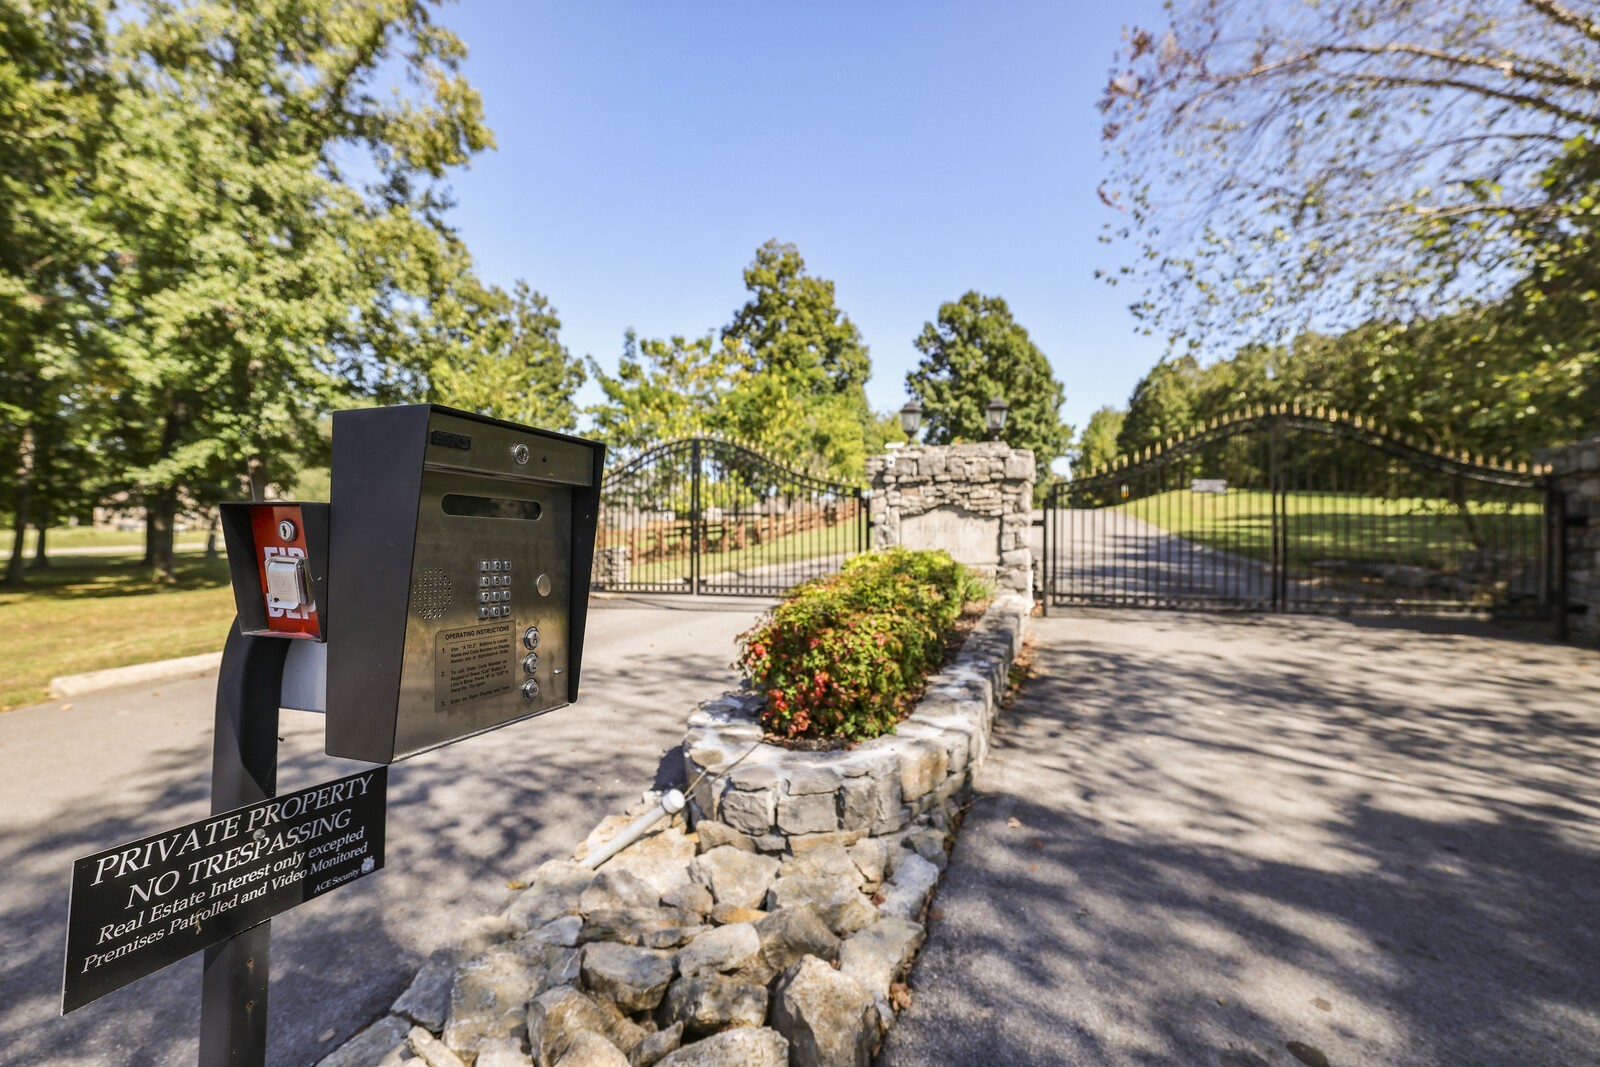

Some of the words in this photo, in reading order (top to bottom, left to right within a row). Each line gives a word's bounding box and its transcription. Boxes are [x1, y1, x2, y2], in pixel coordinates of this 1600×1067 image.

[445, 631, 474, 640] OPERATING
[476, 626, 509, 635] INSTRUCTIONS
[90, 814, 243, 886] PRIVATE
[244, 773, 374, 832] PROPERTY
[124, 870, 180, 910] NO
[188, 808, 351, 885] TRESPASSING
[314, 879, 332, 894] ACE
[332, 867, 360, 886] Security
[81, 929, 164, 974] Premises
[167, 897, 238, 936] Patrolled
[240, 882, 267, 904] and
[271, 868, 308, 891] Video
[309, 842, 368, 876] Monitored
[96, 911, 143, 945] Real
[148, 891, 206, 924] Estate
[209, 866, 270, 899] Interest
[274, 850, 305, 877] only
[308, 826, 364, 859] excepted
